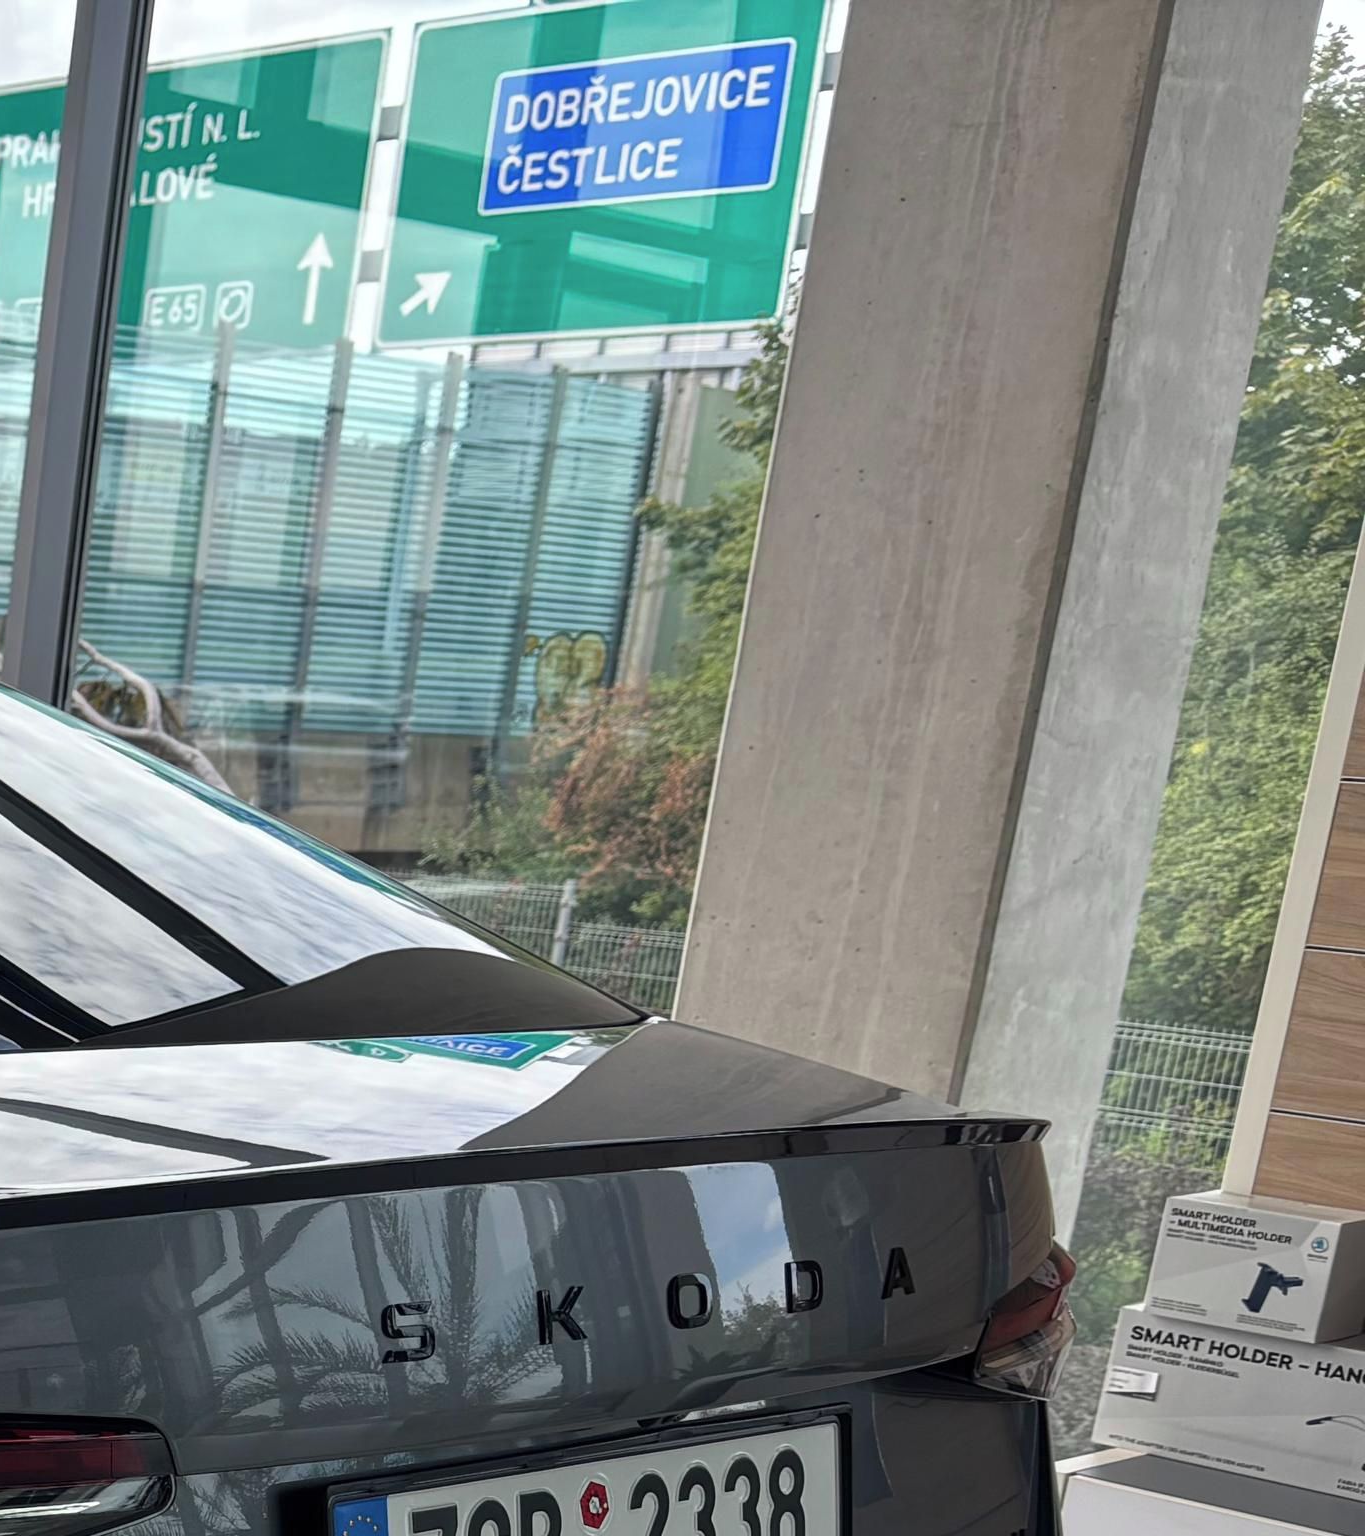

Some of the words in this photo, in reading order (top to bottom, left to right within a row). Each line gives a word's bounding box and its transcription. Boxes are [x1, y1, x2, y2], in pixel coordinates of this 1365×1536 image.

[504, 64, 776, 134] DOBŘEJOVICE
[137, 101, 197, 152] STÍ
[130, 152, 218, 206] LOVÉ
[496, 138, 683, 194] ČESTLICE
[1171, 1207, 1211, 1222] SMART
[1212, 1213, 1257, 1228] HOLDER
[1177, 1219, 1245, 1238] MULTIMEDIA
[1246, 1229, 1293, 1245] HOLDER
[1129, 1325, 1205, 1352] SMART
[1208, 1340, 1294, 1371] HOLDER
